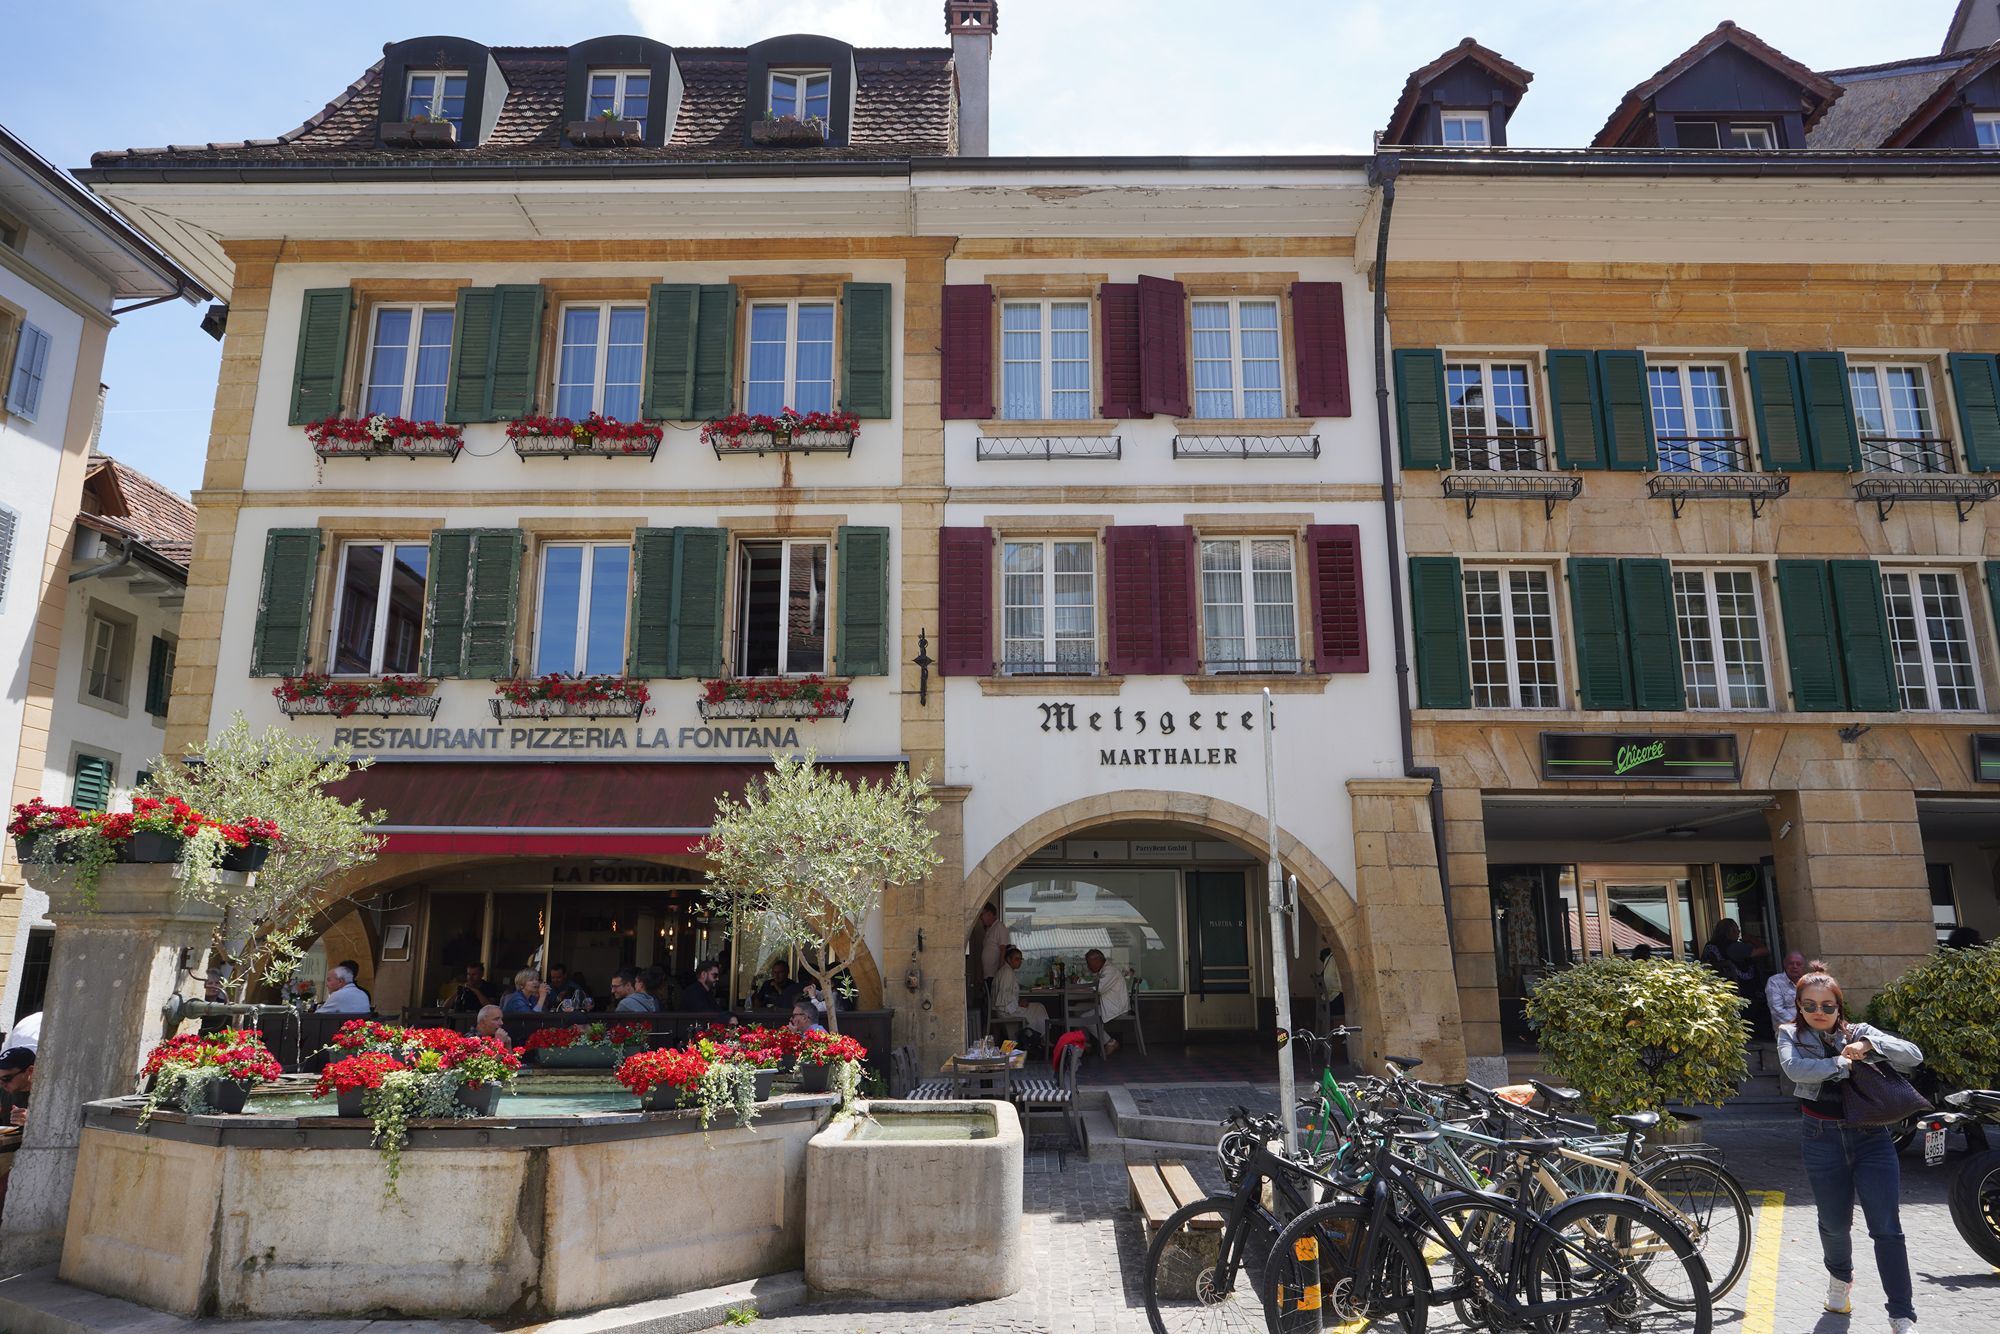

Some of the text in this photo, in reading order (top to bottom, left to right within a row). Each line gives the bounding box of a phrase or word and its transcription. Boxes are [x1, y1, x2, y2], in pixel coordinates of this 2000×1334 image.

[334, 727, 800, 750] RESTAURANT PIZZERIA LA FONTANA
[1099, 748, 1238, 766] MARTHALER
[552, 866, 693, 882] LA FONTANA
